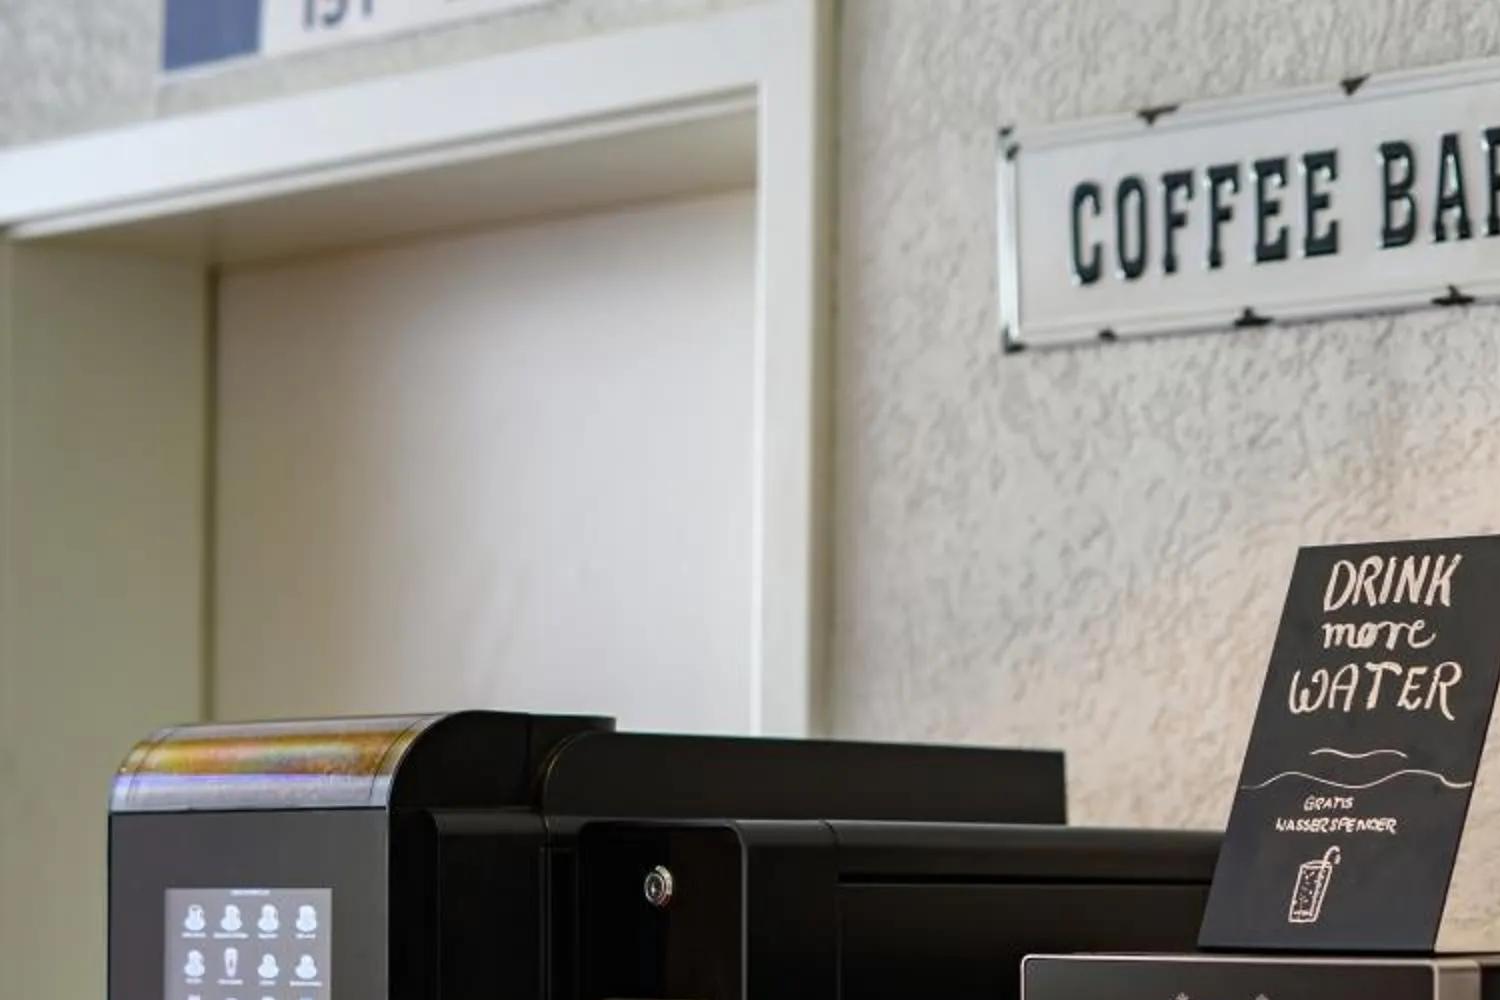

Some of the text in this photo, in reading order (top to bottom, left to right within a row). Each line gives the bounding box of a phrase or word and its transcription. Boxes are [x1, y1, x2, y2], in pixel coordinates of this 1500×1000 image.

[1071, 149, 1339, 287] COFFEE
[1323, 553, 1463, 612] DRINK
[1322, 619, 1437, 650] more
[1289, 661, 1463, 721] WATER
[1275, 816, 1398, 835] WASSERSPENDER
[1303, 795, 1354, 812] GRATIS
